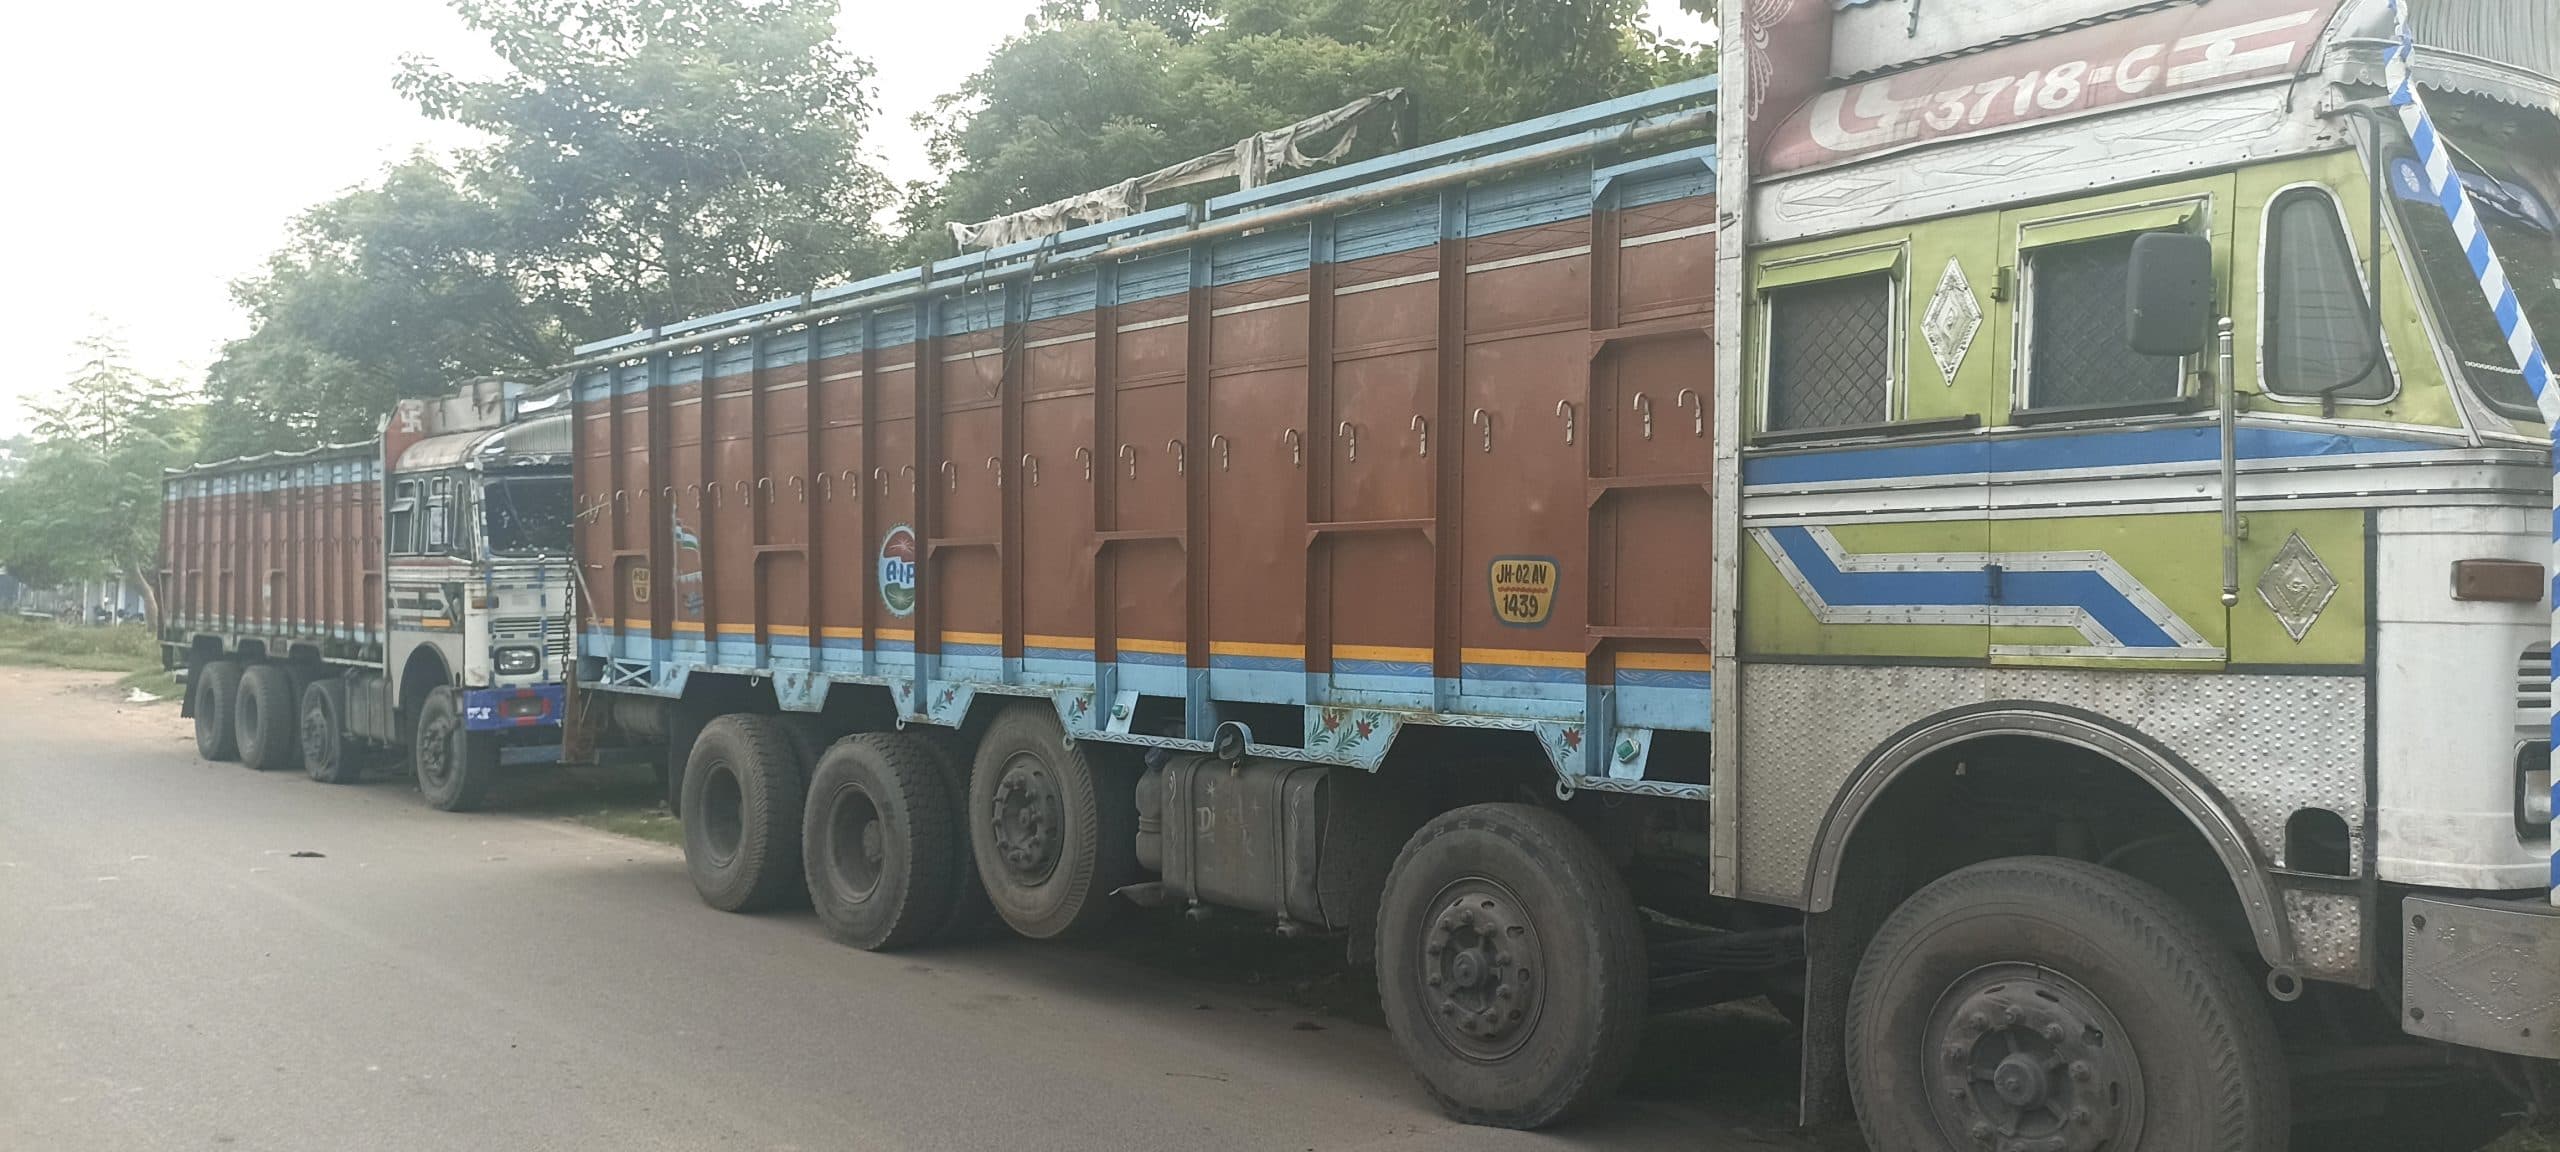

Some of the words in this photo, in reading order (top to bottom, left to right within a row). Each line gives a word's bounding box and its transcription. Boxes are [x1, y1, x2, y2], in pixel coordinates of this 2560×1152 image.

[1496, 564, 1530, 584] JH-02
[1532, 564, 1547, 584] AV
[1503, 594, 1539, 618] 1439
